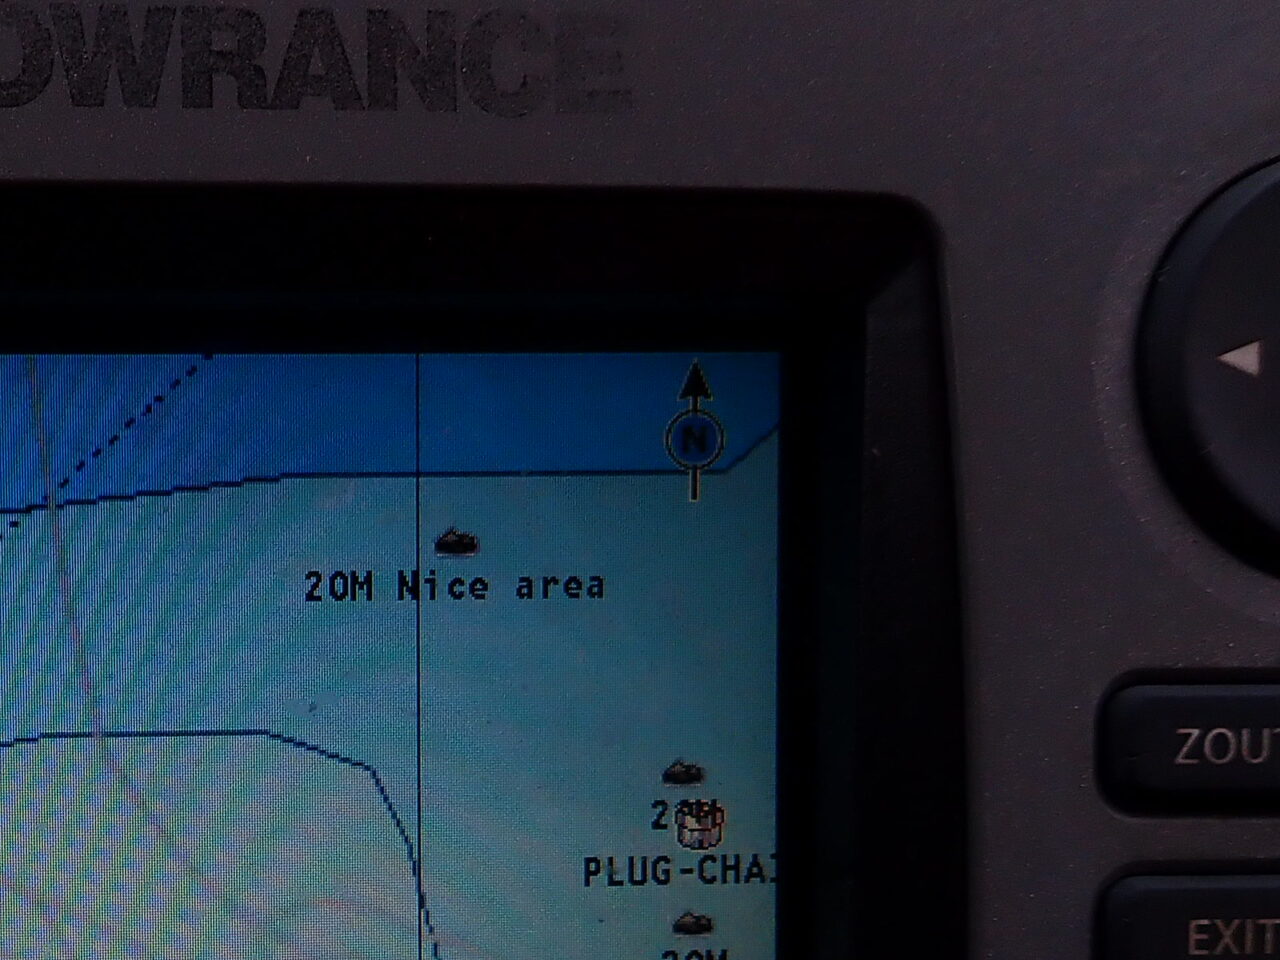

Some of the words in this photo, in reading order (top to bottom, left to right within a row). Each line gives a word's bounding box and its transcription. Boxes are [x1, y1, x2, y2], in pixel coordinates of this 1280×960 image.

[304, 570, 373, 602] 20M
[397, 569, 490, 601] Nice
[515, 575, 605, 600] area
[1174, 727, 1280, 765] ZOU
[1187, 918, 1280, 956] EXIT
